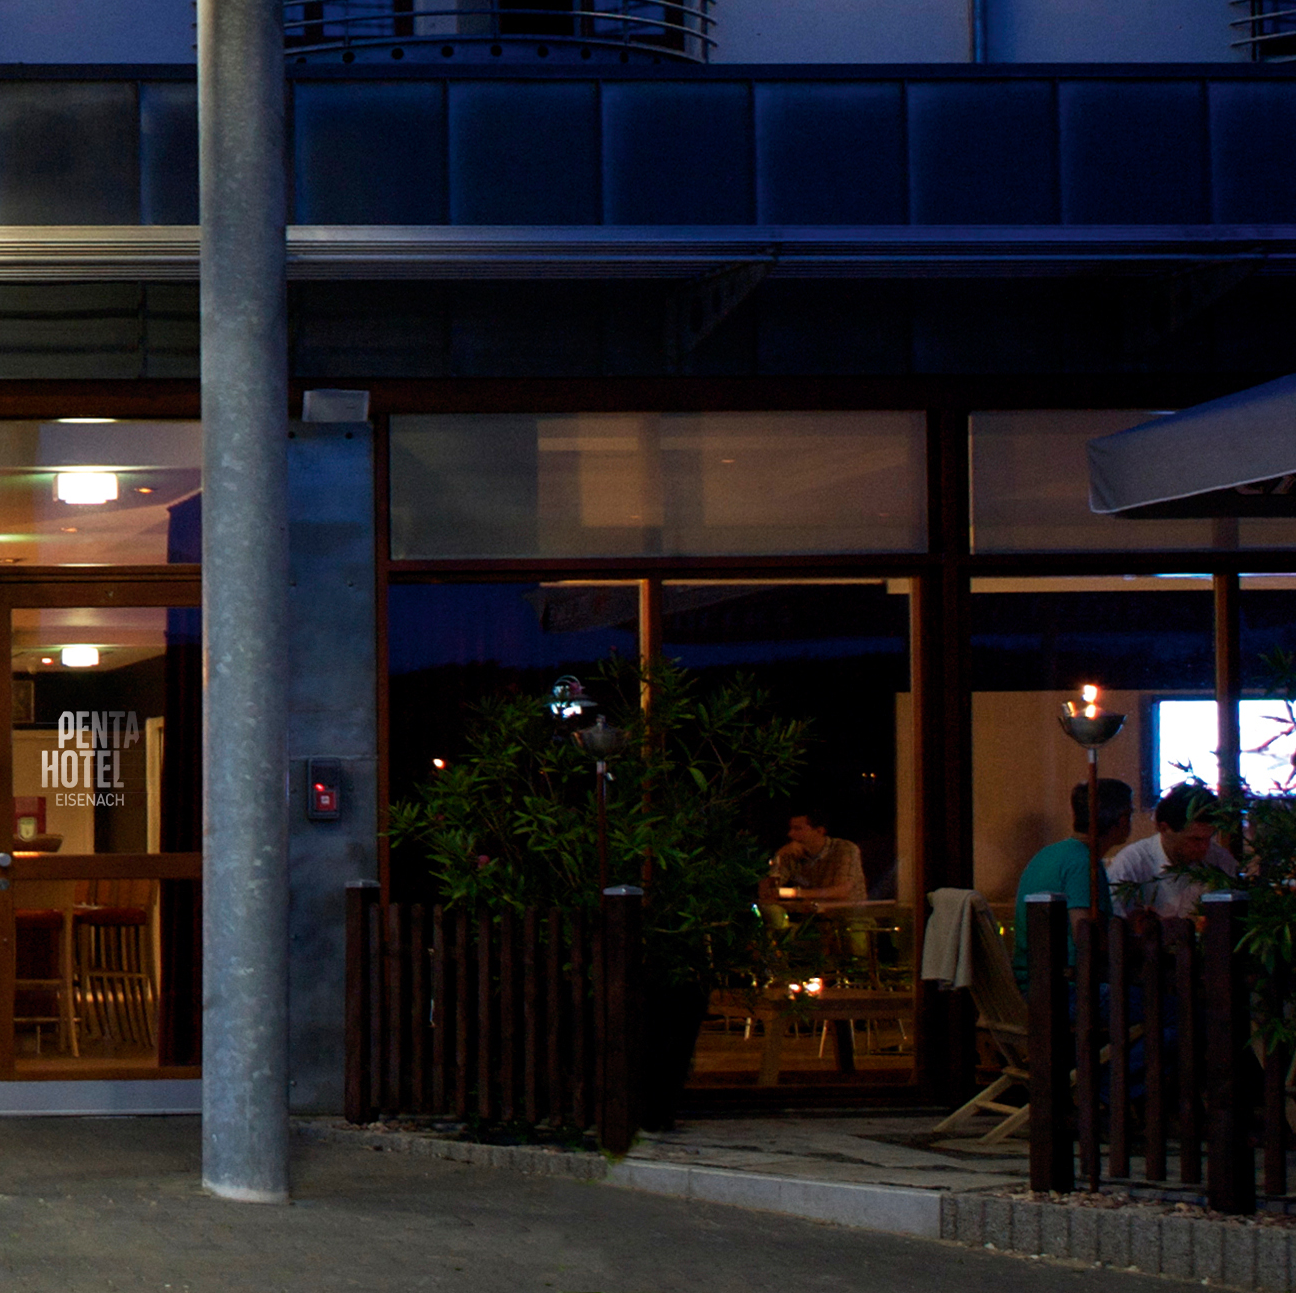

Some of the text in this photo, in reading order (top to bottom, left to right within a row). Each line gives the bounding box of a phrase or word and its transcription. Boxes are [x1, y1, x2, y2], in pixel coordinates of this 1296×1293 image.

[58, 710, 140, 749] PENTA
[41, 749, 125, 789] HOTEL
[55, 793, 125, 807] EISENACH
